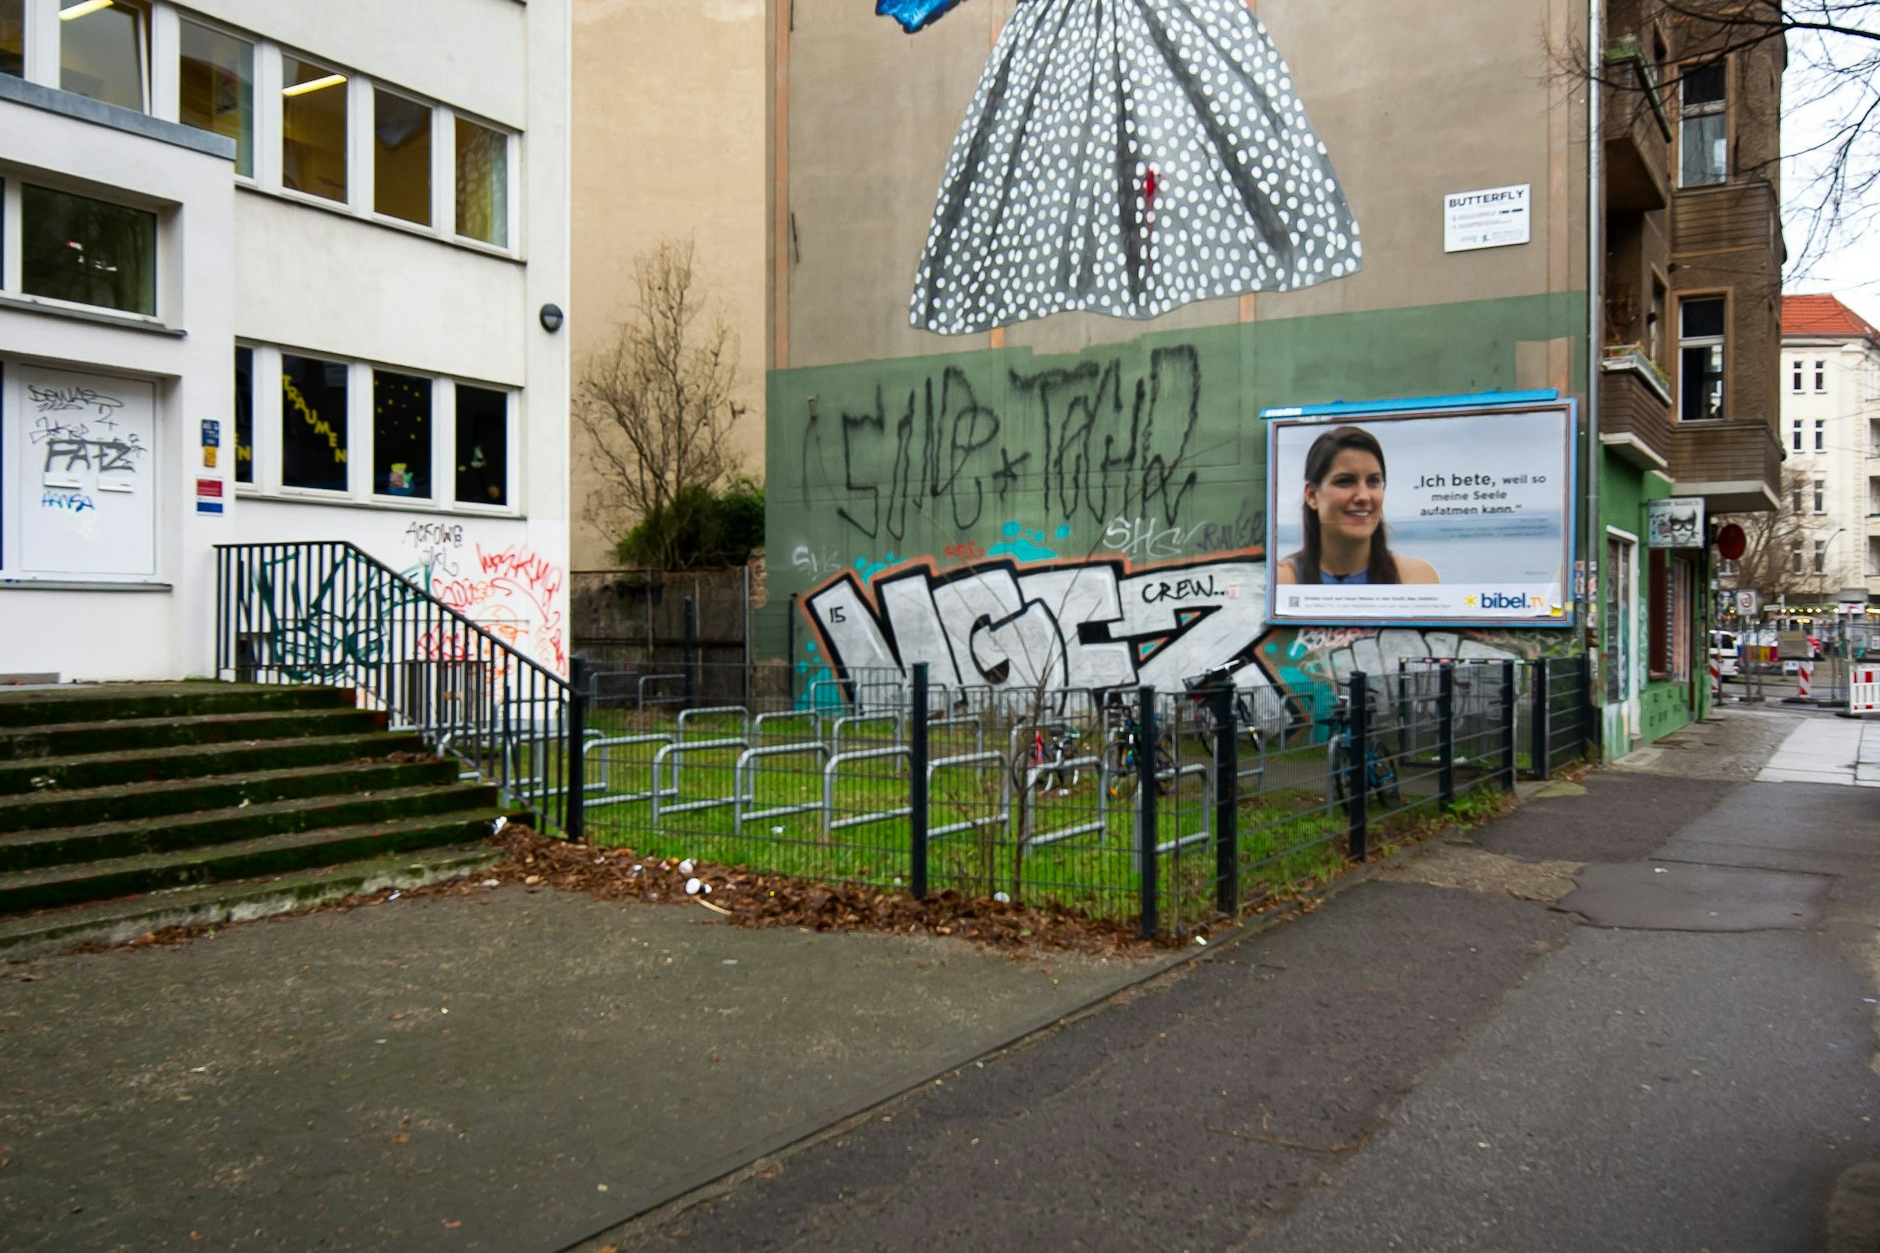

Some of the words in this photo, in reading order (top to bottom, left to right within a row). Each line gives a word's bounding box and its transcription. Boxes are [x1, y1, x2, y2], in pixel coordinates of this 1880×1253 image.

[1449, 189, 1524, 207] BUTTERFLY
[1452, 473, 1496, 487] bete,
[1502, 474, 1528, 484] weil
[1531, 475, 1547, 484] so
[1431, 491, 1469, 501] meine
[1473, 490, 1507, 500] Seele
[1420, 505, 1478, 516] aufatmen
